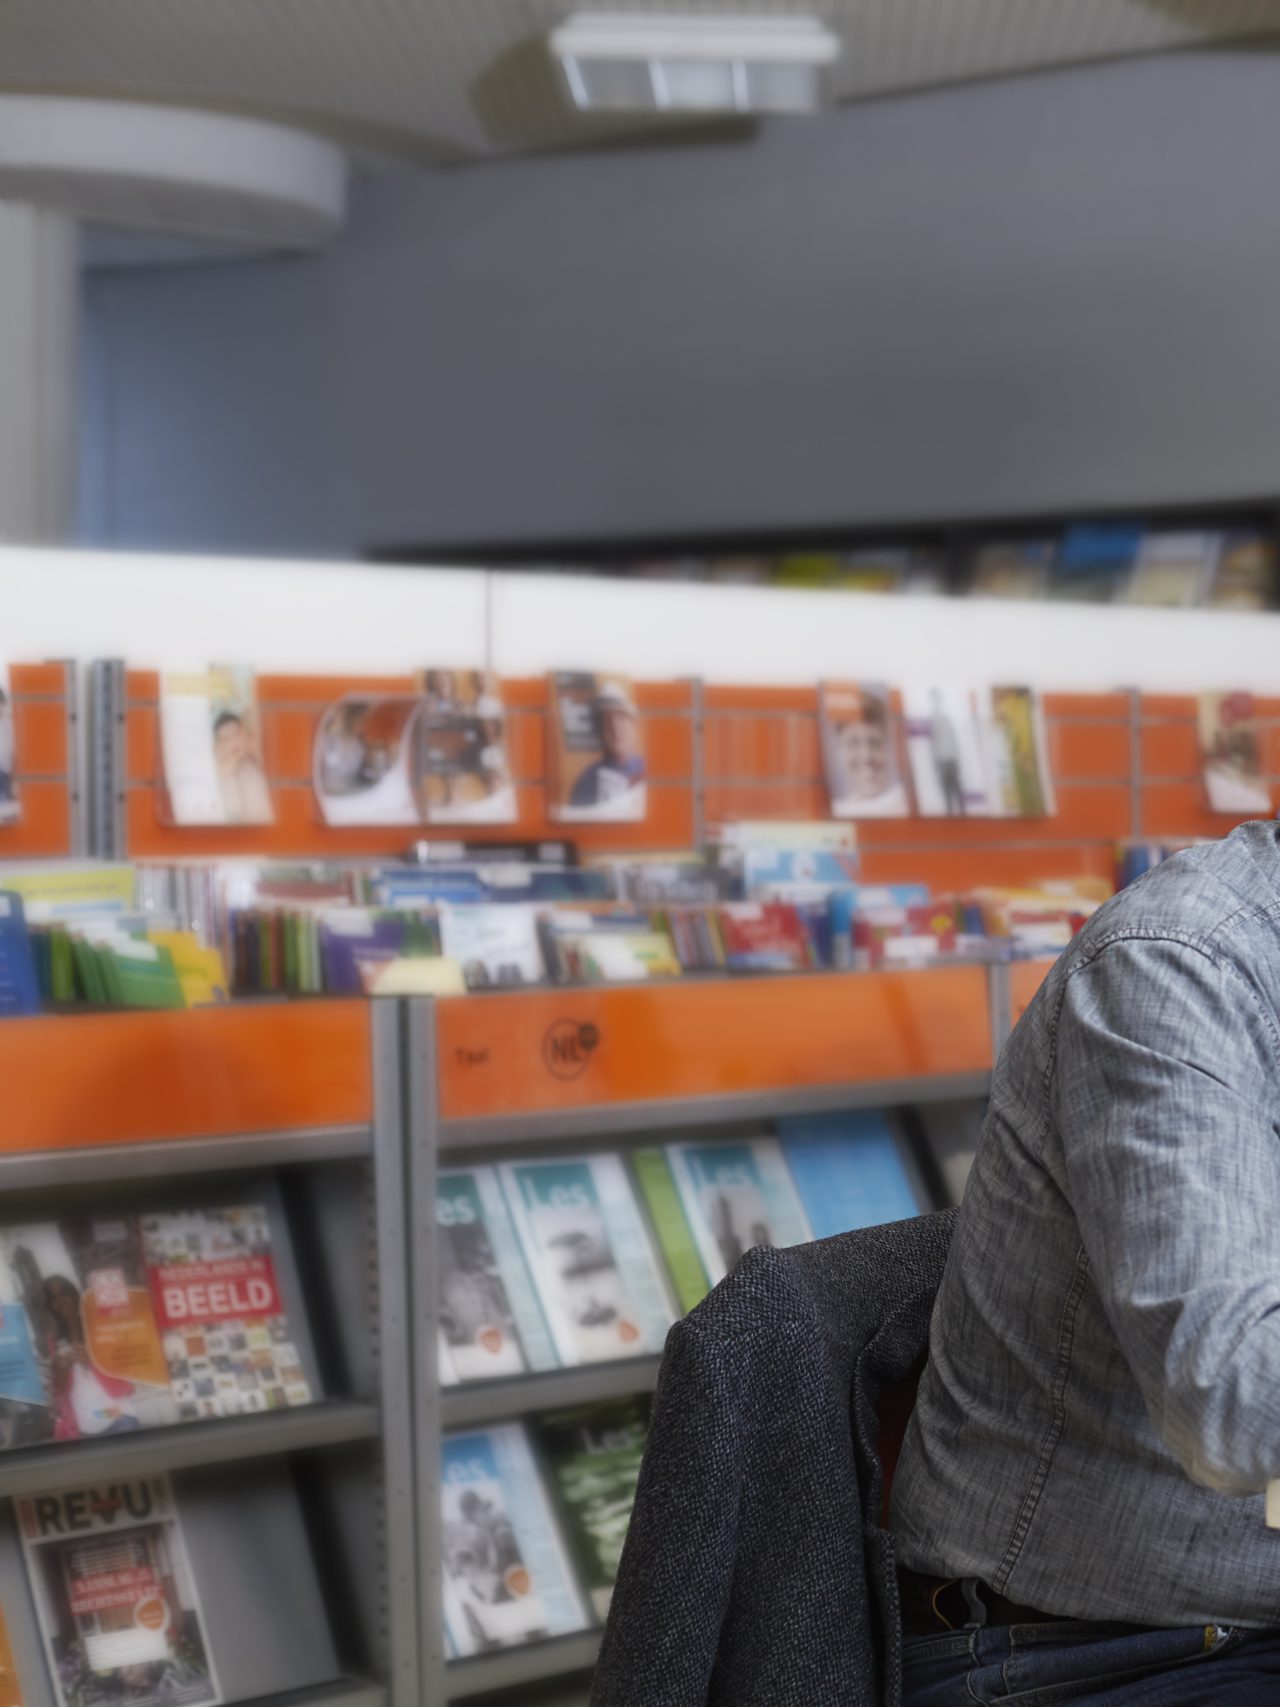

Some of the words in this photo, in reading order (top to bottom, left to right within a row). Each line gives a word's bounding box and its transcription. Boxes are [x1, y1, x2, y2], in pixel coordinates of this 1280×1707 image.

[437, 1196, 476, 1226] es
[524, 1176, 590, 1209] Les
[163, 1278, 273, 1320] BEELD
[36, 1479, 153, 1535] REVU
